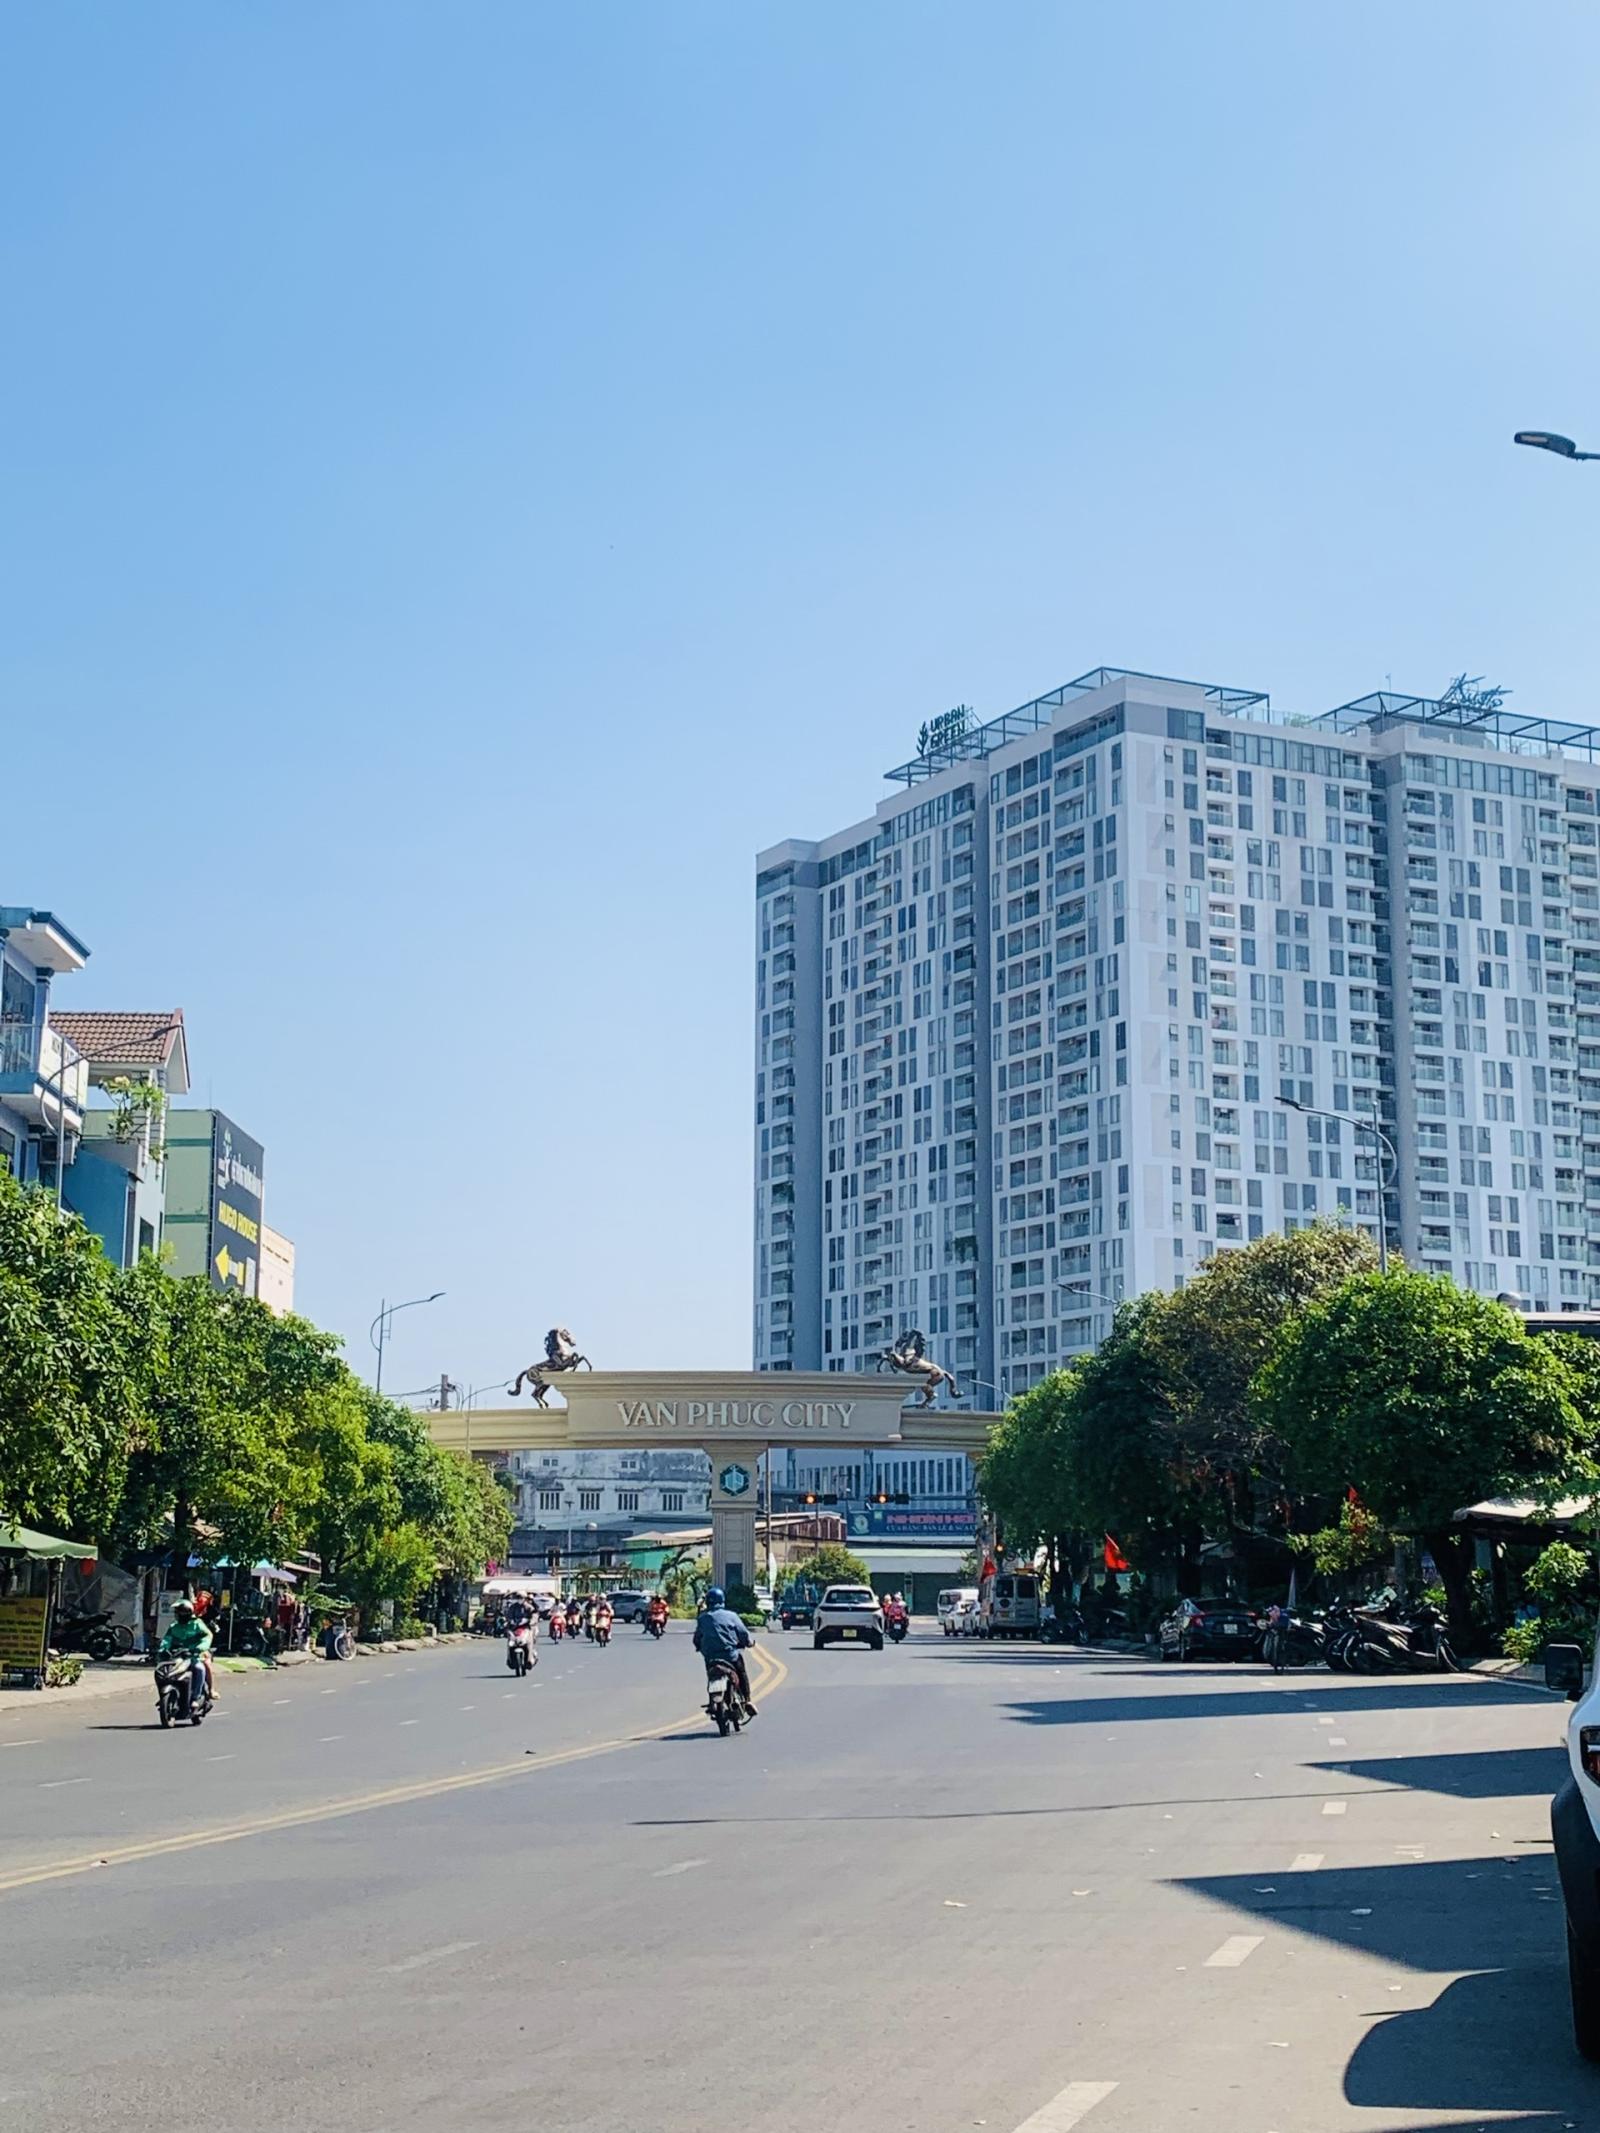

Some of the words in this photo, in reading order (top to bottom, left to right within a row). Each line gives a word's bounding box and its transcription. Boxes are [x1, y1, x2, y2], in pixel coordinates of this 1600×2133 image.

[930, 704, 965, 733] URBAN
[930, 720, 965, 749] GREEN
[237, 1211, 258, 1245] HOUSE
[617, 1401, 678, 1427] VAN
[687, 1401, 775, 1428] PHUC
[782, 1401, 856, 1428] CITY
